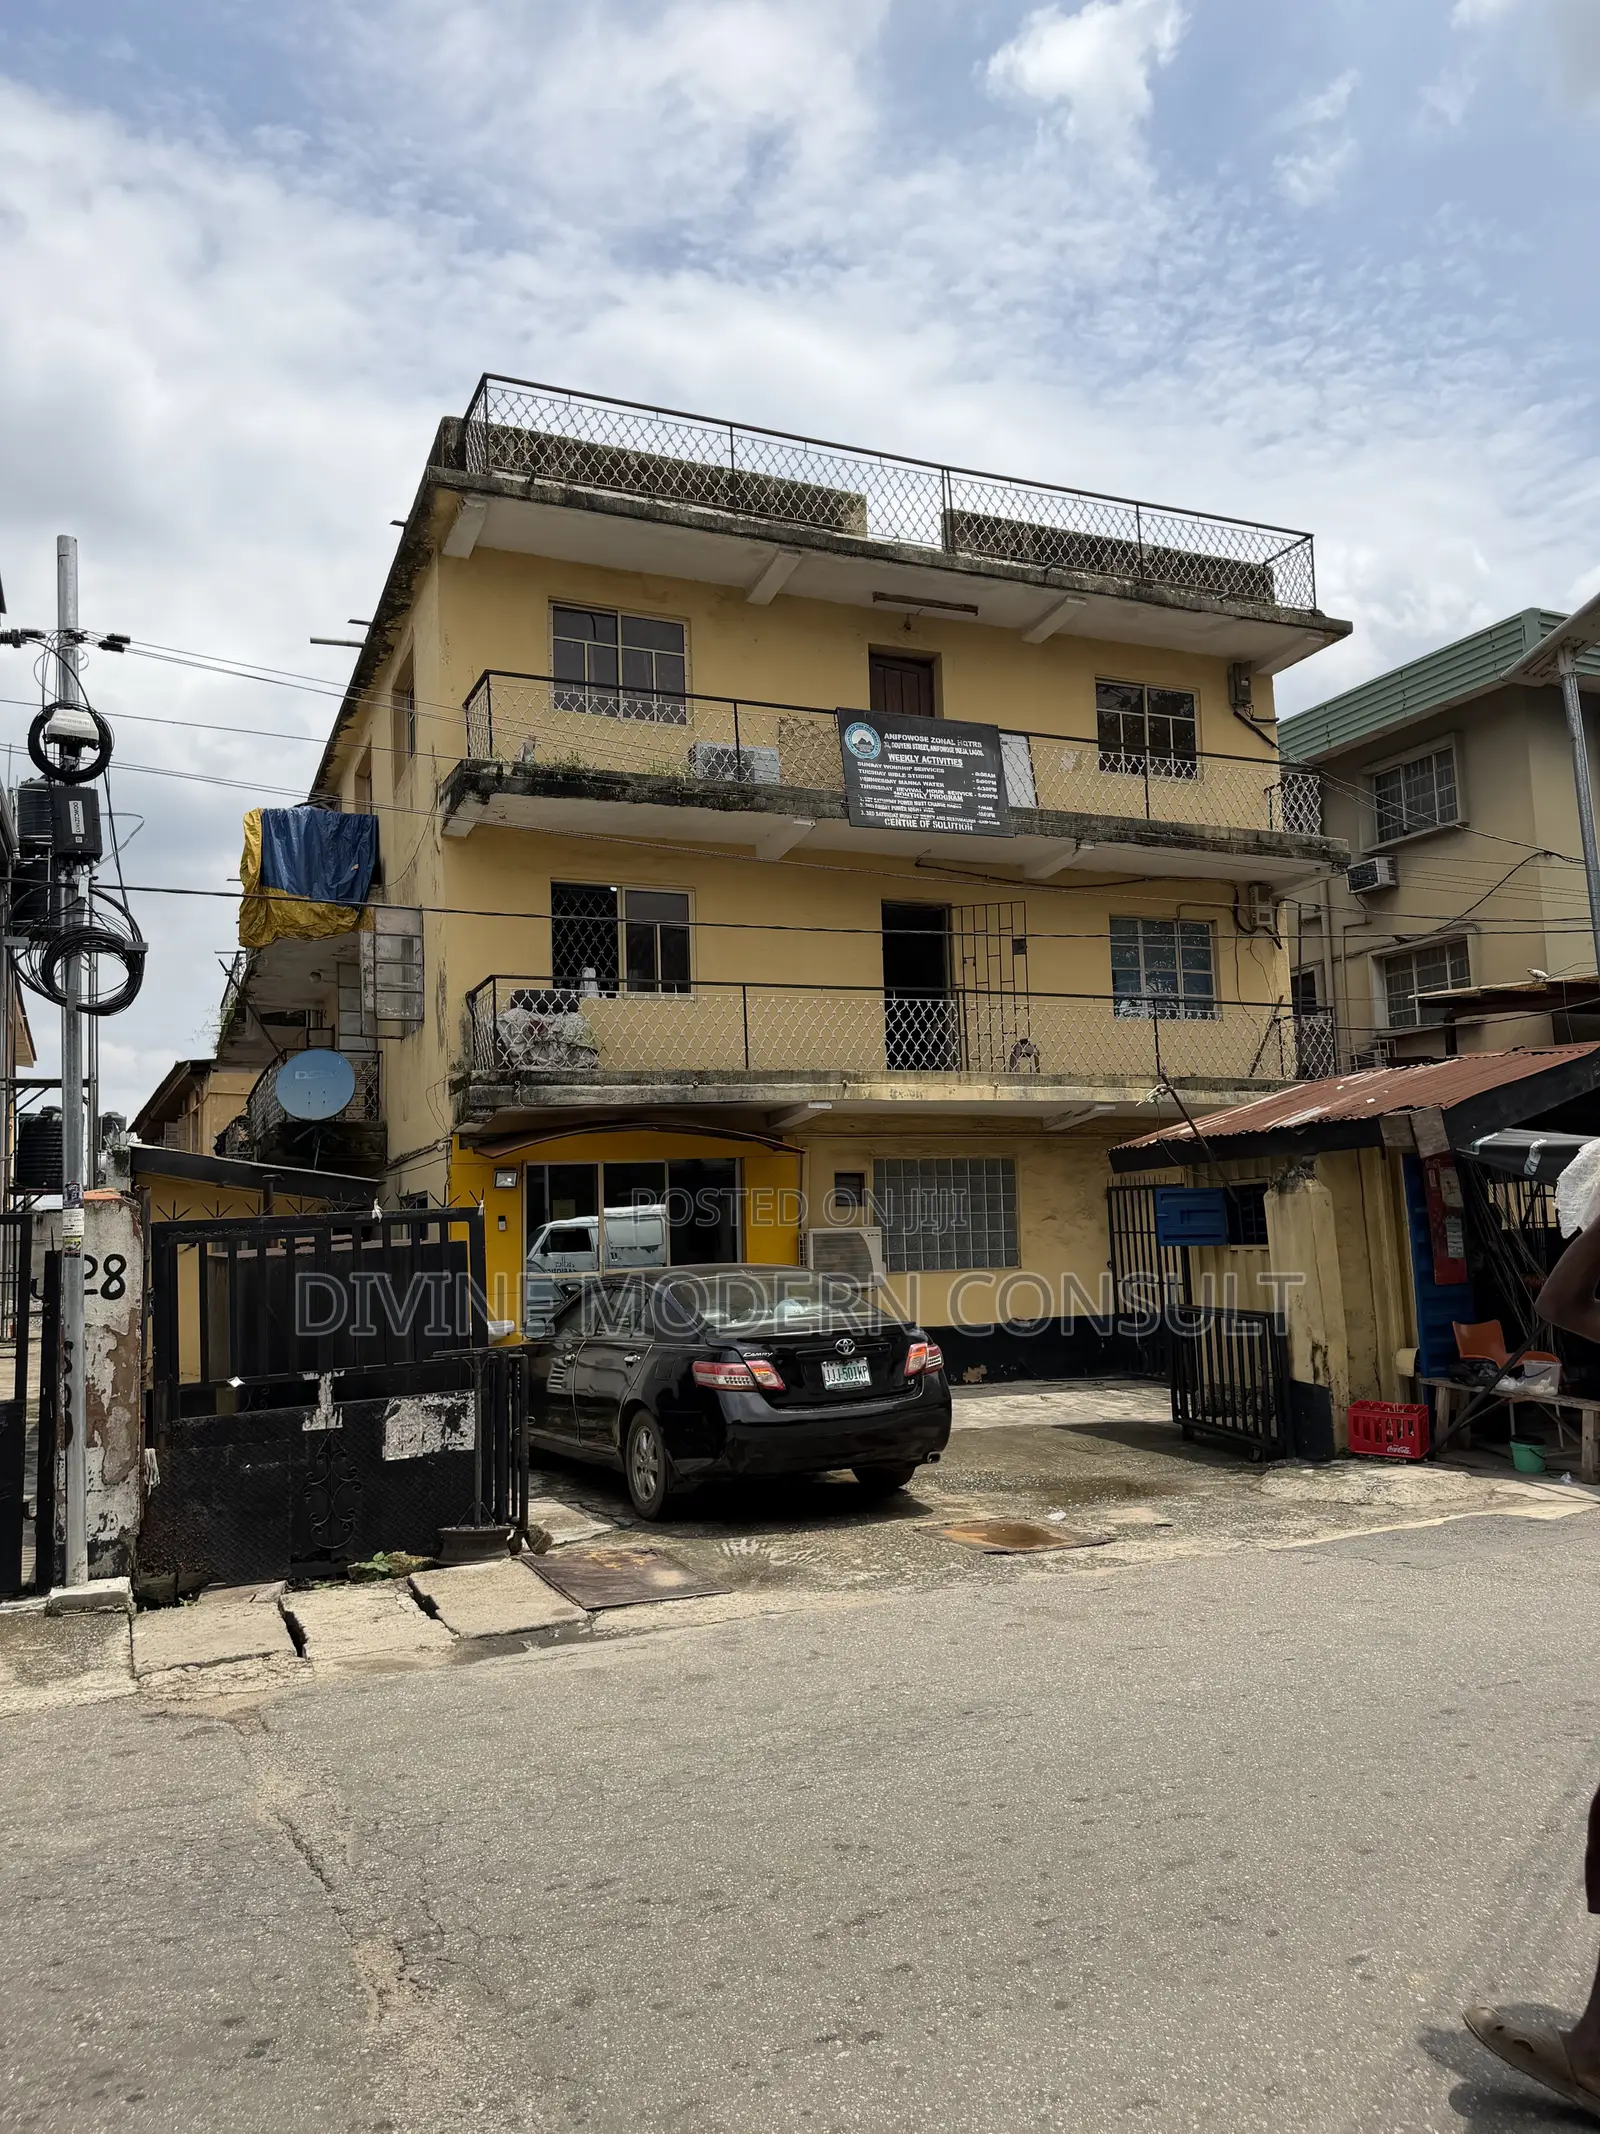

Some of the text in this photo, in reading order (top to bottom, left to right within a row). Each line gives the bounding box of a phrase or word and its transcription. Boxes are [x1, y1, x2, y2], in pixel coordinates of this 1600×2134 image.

[884, 733, 929, 742] ANIFOWOSE
[930, 736, 956, 746] ZONAL
[888, 753, 964, 767] WEEKLY ACTIVITIES
[857, 761, 882, 769] SUNDAY
[860, 783, 893, 791] THURSDAY
[894, 791, 928, 799] MONTHLY
[884, 817, 973, 831] CENTRE OF SOLUTION
[1387, 1445, 1411, 1454] Coca-Cola
